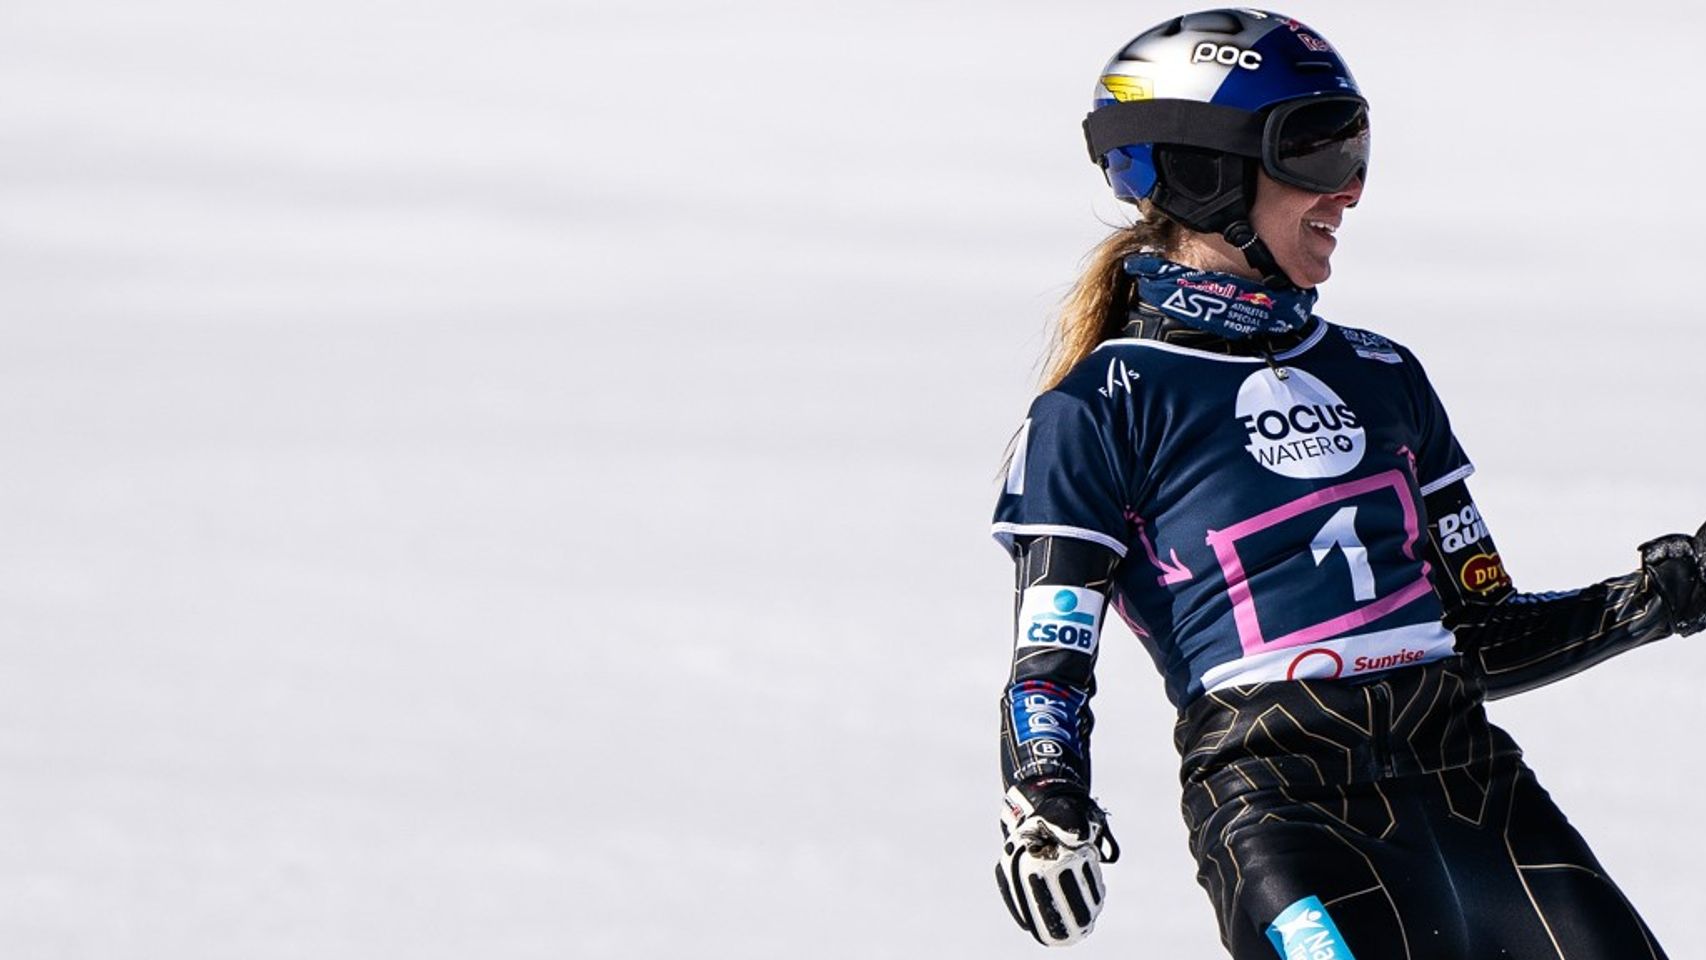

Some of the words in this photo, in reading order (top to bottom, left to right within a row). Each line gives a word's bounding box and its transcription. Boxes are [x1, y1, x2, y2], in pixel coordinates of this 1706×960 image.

[1161, 287, 1228, 322] ASP
[1226, 310, 1262, 327] SPECIAL
[1235, 403, 1364, 446] FOCUS
[1252, 436, 1336, 467] WATER
[1310, 506, 1377, 602] 1
[1027, 622, 1093, 649] ČSOB
[1353, 648, 1425, 674] Sunrise
